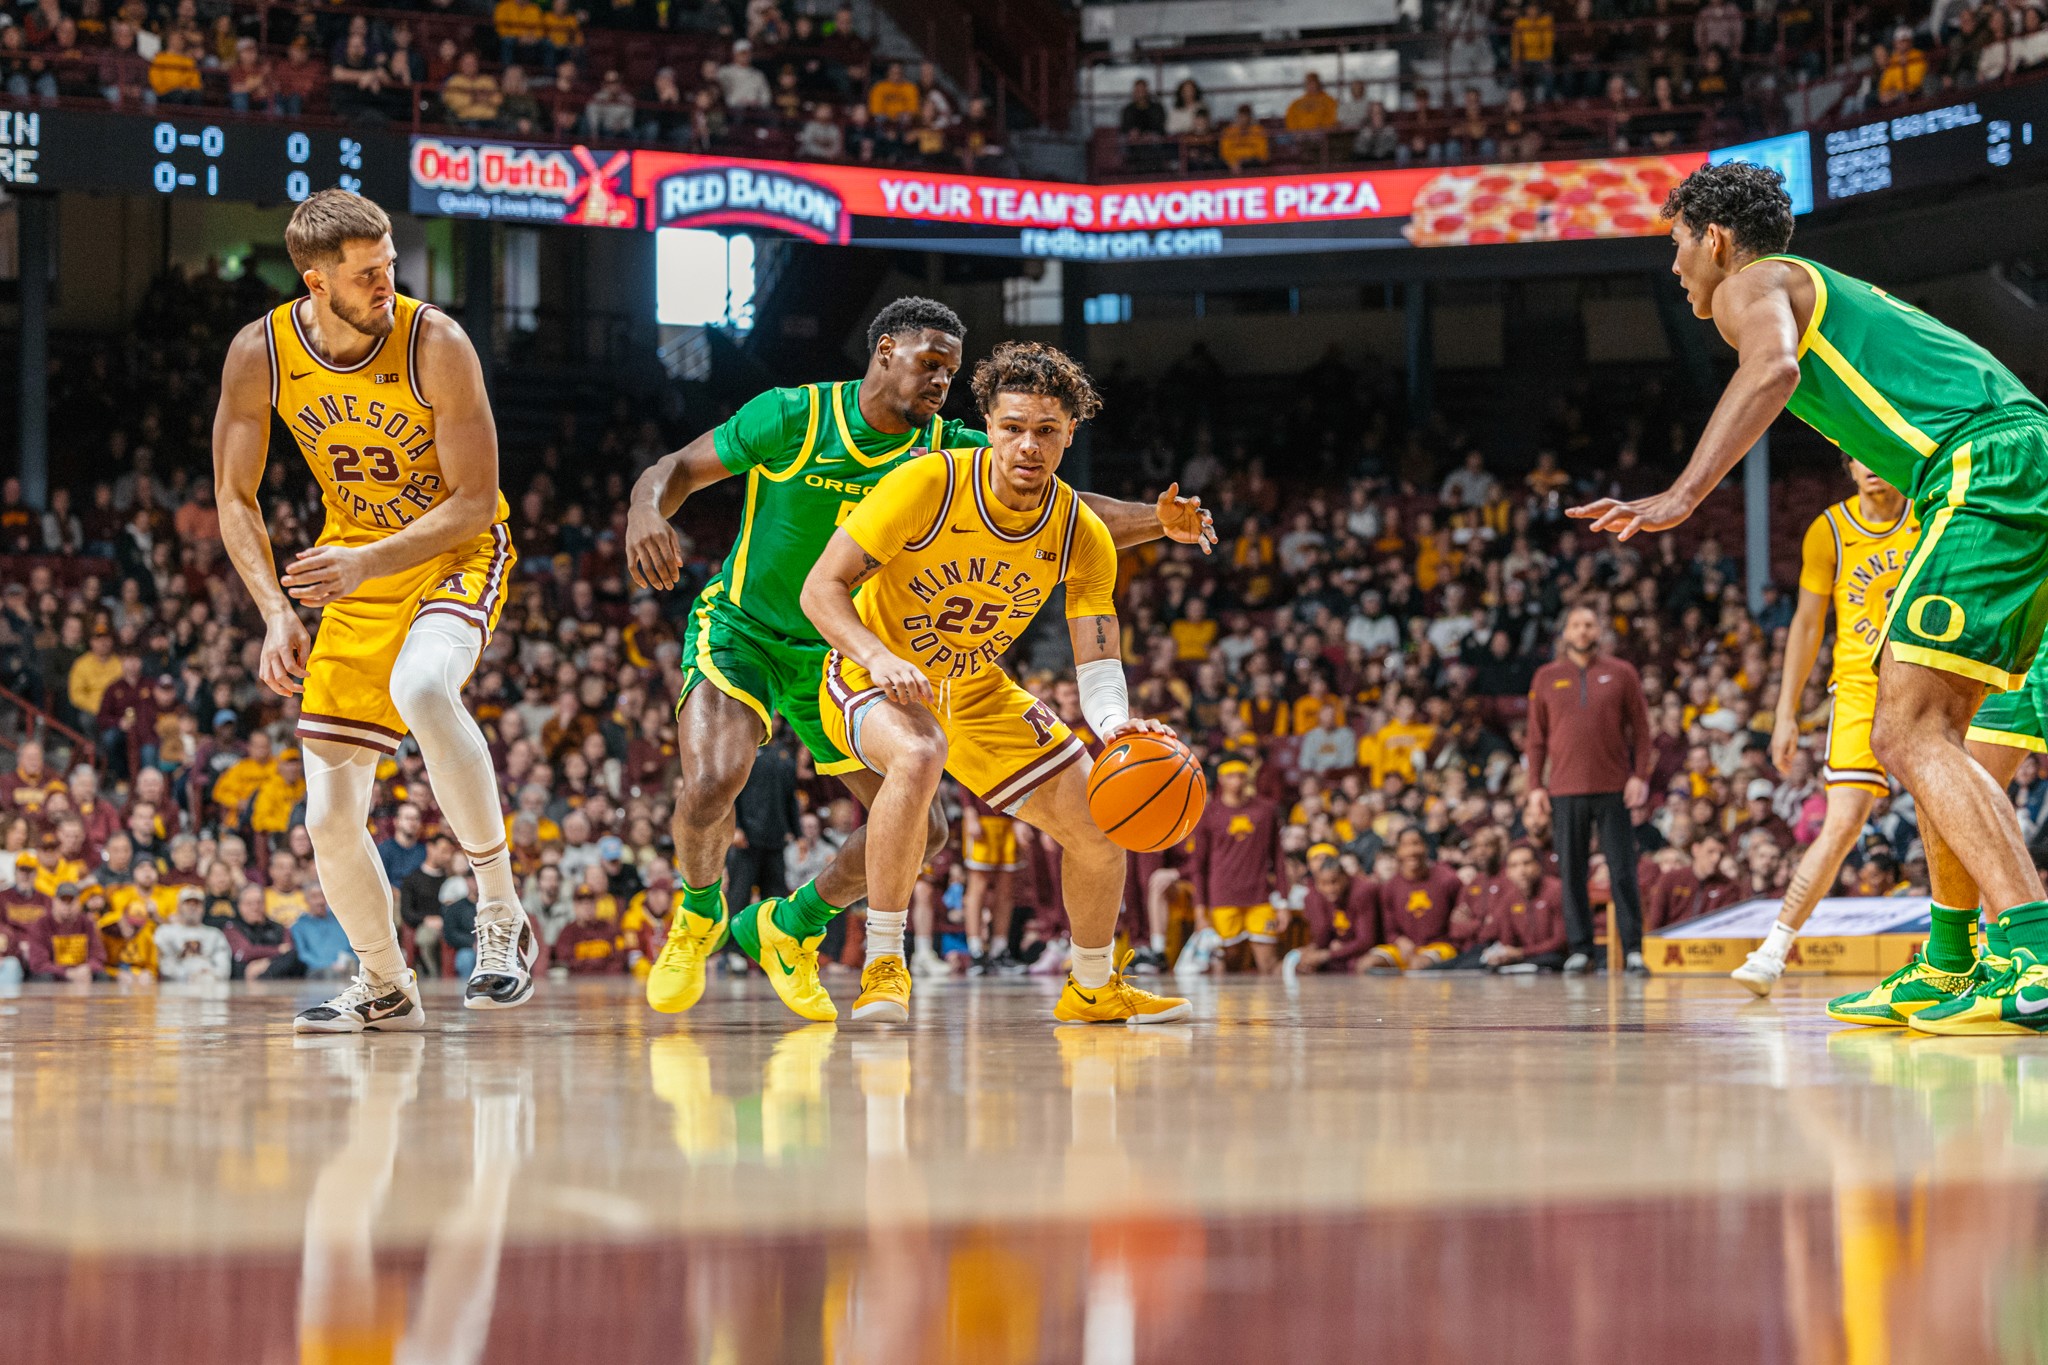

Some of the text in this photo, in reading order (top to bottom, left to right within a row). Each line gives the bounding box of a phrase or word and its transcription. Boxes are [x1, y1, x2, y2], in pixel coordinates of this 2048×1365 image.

[154, 122, 224, 157] 0-0
[287, 131, 310, 164] 0
[339, 136, 362, 170] %
[412, 141, 572, 193] Old Dutch
[154, 161, 218, 195] 0-1
[287, 169, 310, 202] 0
[662, 168, 836, 232] RED BARON
[880, 179, 1380, 227] YOUR TEAM'S FAVORITE PIZZA
[1021, 226, 1223, 260] redbaron.com
[327, 444, 401, 482] 23
[324, 471, 440, 527] OPHERS
[908, 557, 1042, 619] MINNESOTA
[935, 595, 1008, 635] 25
[903, 613, 1014, 678] GOPHERS
